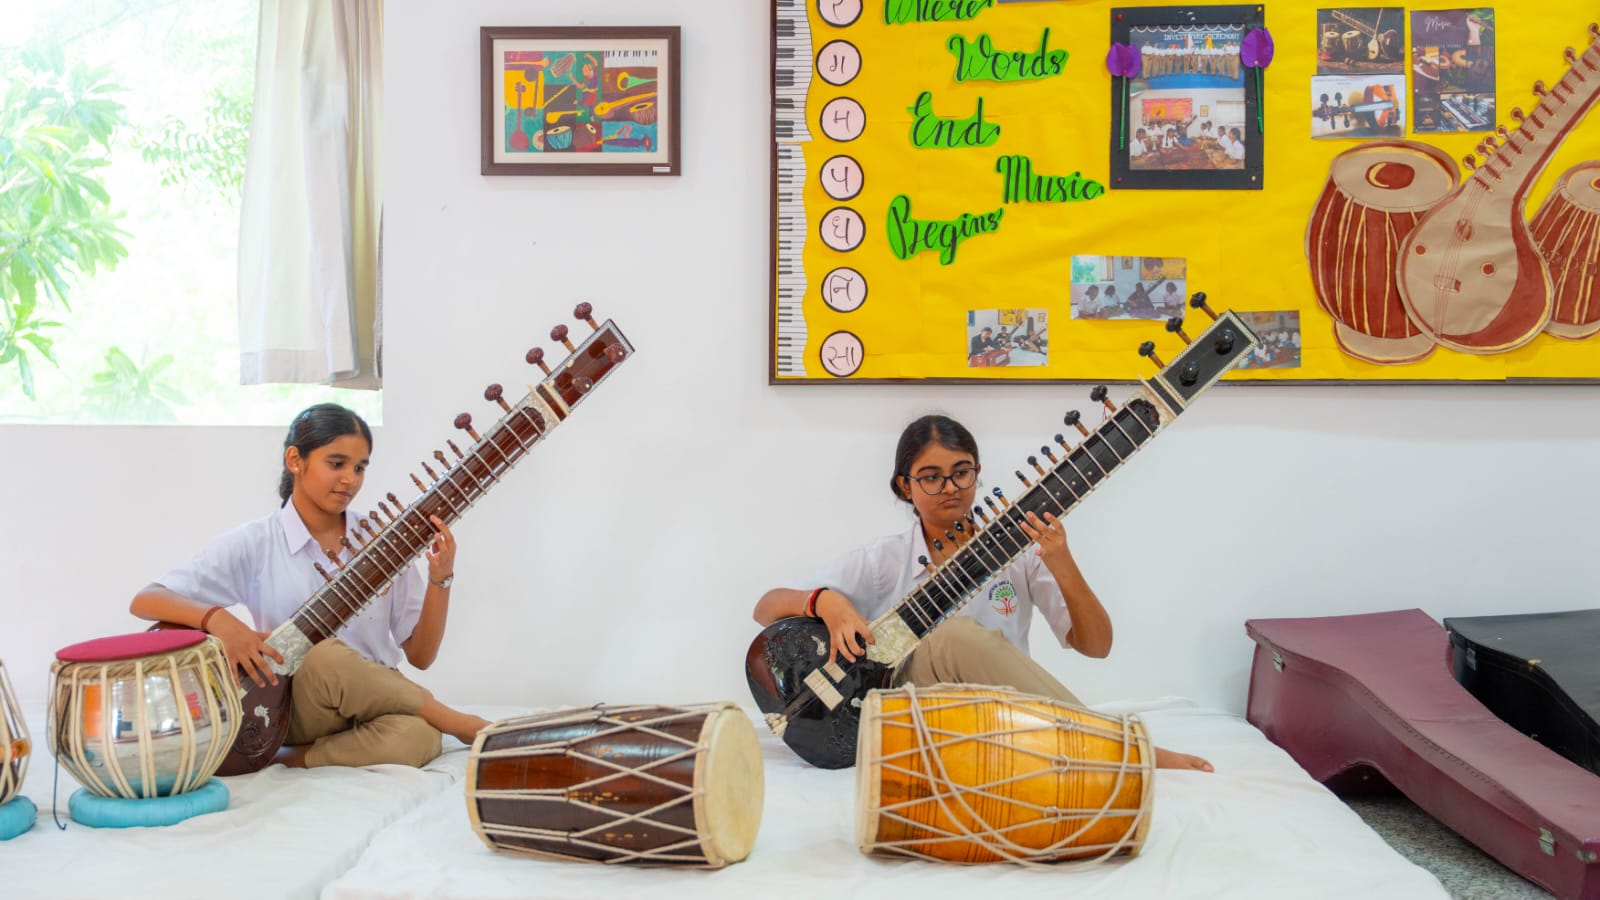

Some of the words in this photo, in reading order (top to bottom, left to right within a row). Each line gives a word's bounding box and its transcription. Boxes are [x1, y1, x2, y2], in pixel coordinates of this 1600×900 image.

[829, 54, 845, 75] ग
[949, 27, 1066, 81] Words
[832, 110, 850, 133] म
[912, 91, 1000, 148] End
[830, 166, 849, 193] प
[996, 155, 1105, 204] Music
[891, 195, 1003, 265] Begins
[829, 274, 854, 303] नि
[827, 346, 856, 370] सा
